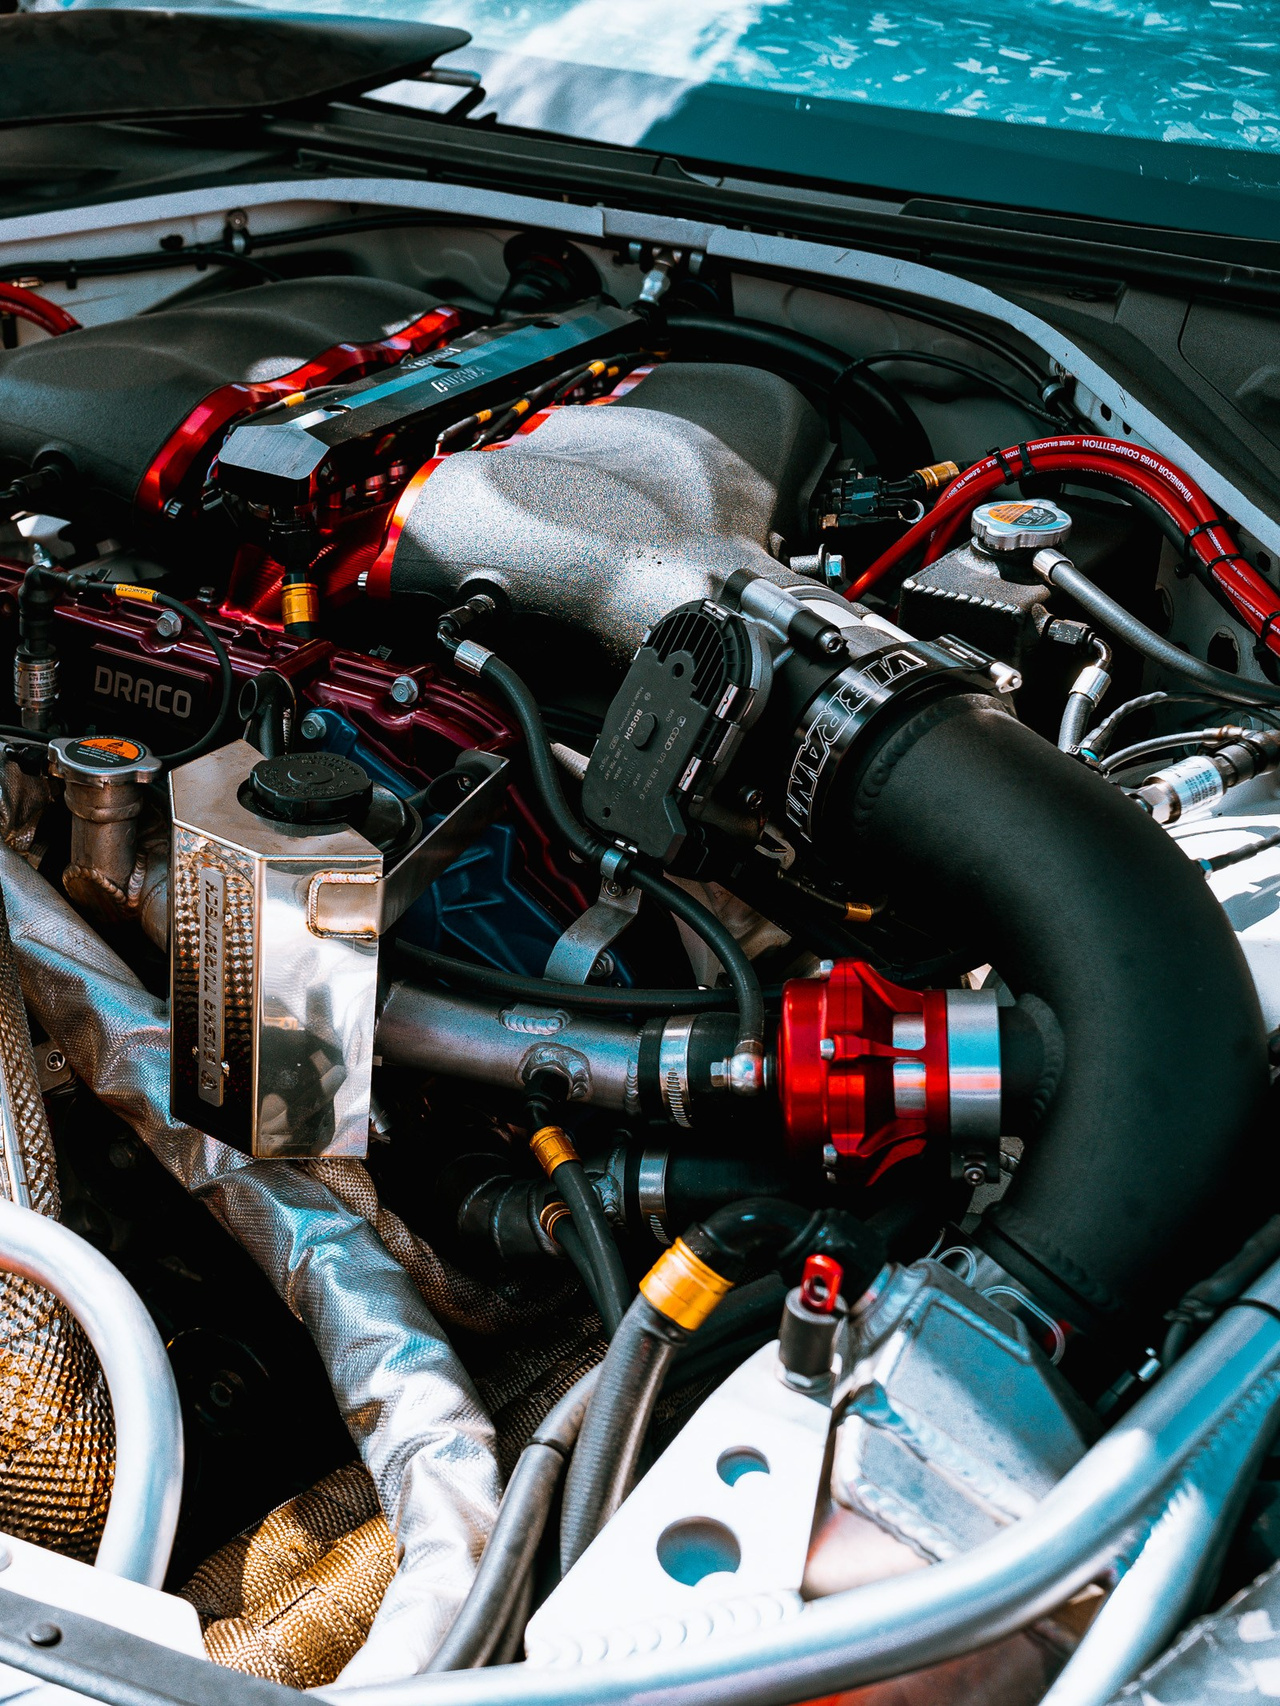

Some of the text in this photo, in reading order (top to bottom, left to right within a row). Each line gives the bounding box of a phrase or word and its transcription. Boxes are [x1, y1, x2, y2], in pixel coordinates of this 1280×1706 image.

[1082, 439, 1140, 460] COMPETITION
[1140, 455, 1159, 469] KV85
[94, 665, 192, 718] DRACO
[624, 708, 643, 740] BOSCH
